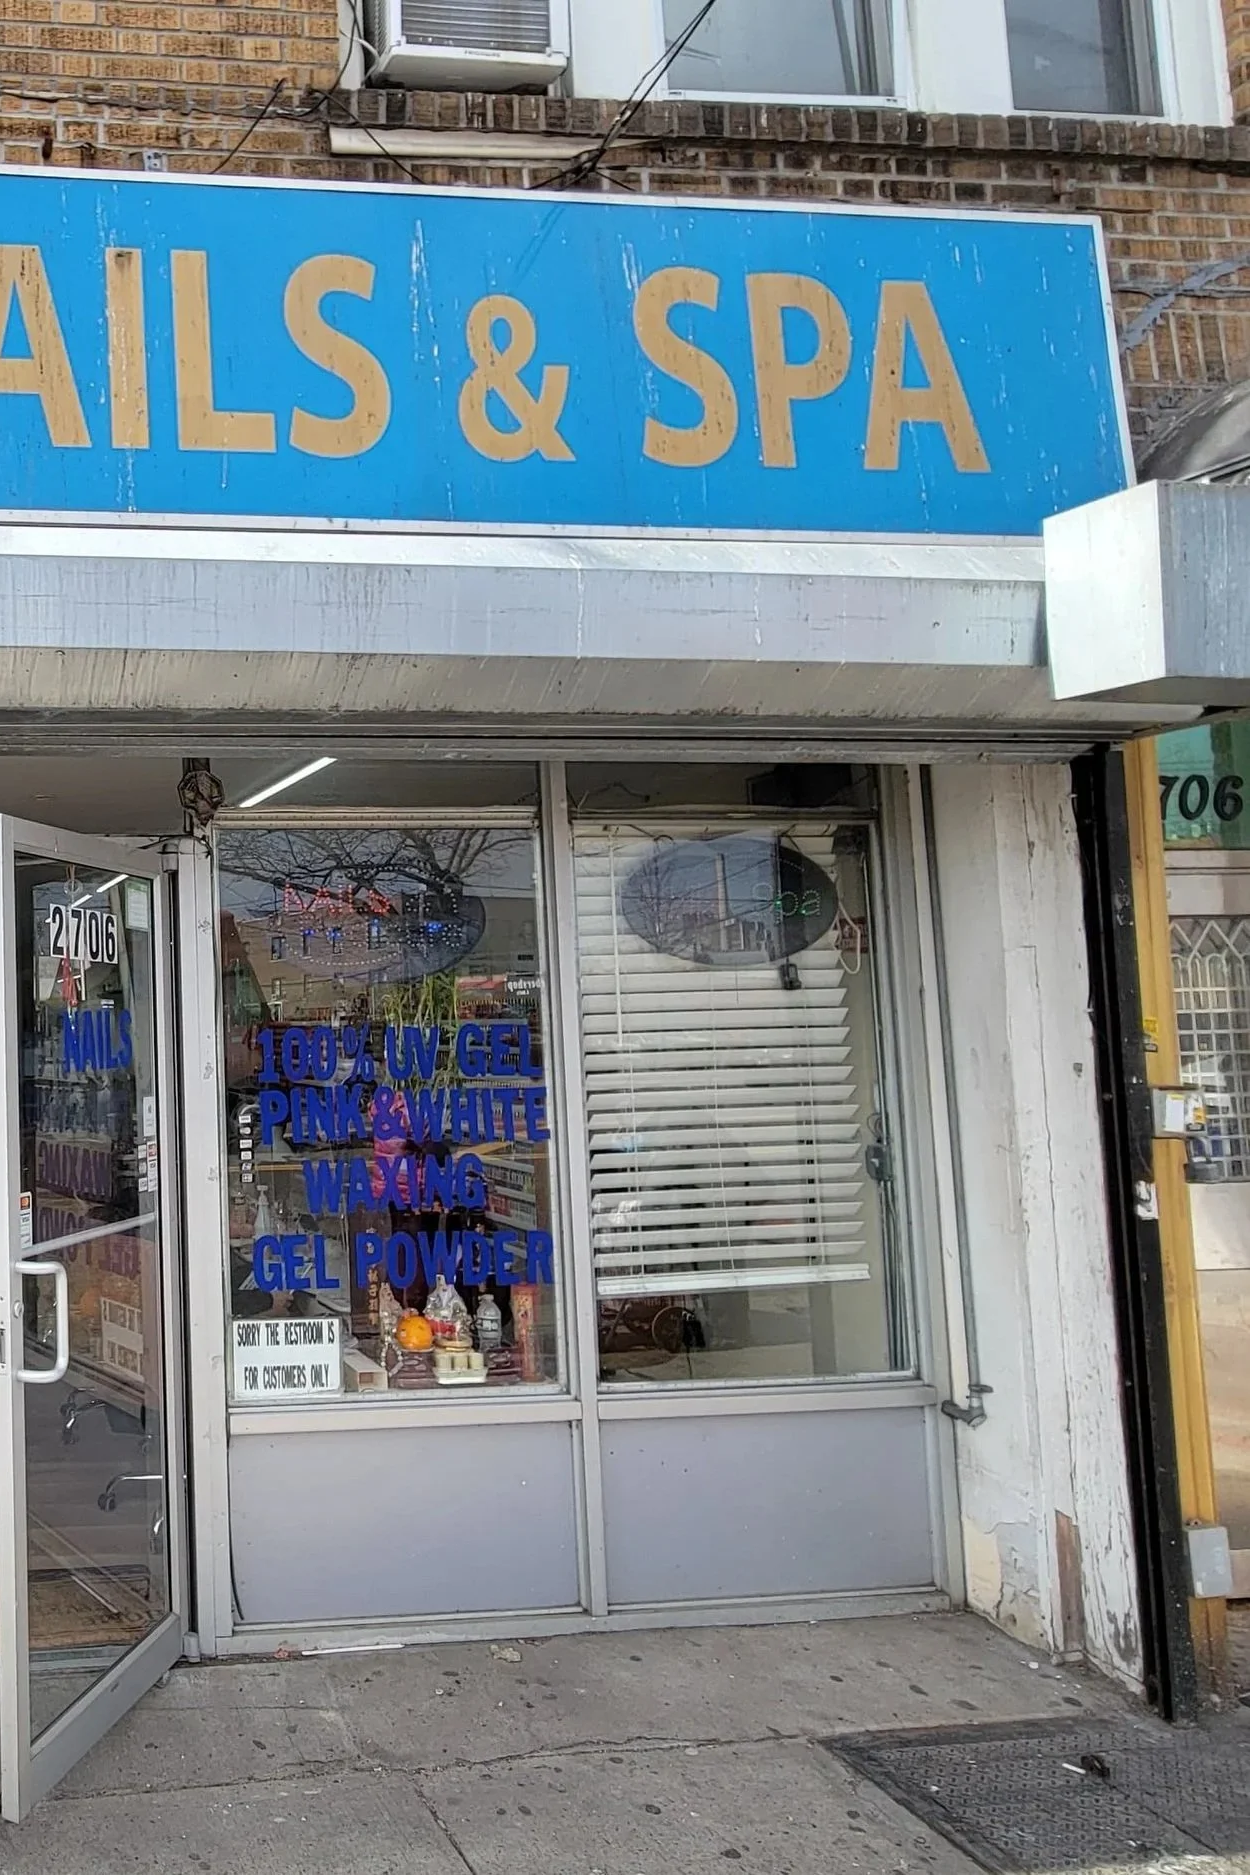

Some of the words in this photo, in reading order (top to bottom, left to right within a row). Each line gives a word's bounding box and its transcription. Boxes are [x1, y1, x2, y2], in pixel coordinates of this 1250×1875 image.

[458, 294, 576, 463] &
[632, 266, 992, 472] SPA
[1158, 774, 1244, 821] 706
[51, 906, 116, 963] 2706
[61, 1008, 133, 1074] NAILS
[256, 1024, 375, 1083] 100%
[384, 1024, 440, 1080] UV
[455, 1022, 543, 1078] GEL
[257, 1085, 551, 1146] PINK&WHITE
[302, 1153, 486, 1216] WAXING
[252, 1233, 340, 1293] GEL
[355, 1229, 556, 1290] POWDER
[237, 1322, 261, 1347] SORRY
[265, 1322, 280, 1346] THE
[284, 1321, 324, 1346] RESTROOM
[327, 1320, 335, 1345] IS
[244, 1366, 259, 1390] FOR
[263, 1364, 307, 1390] CUSTOMERS
[310, 1363, 330, 1389] ONLY
